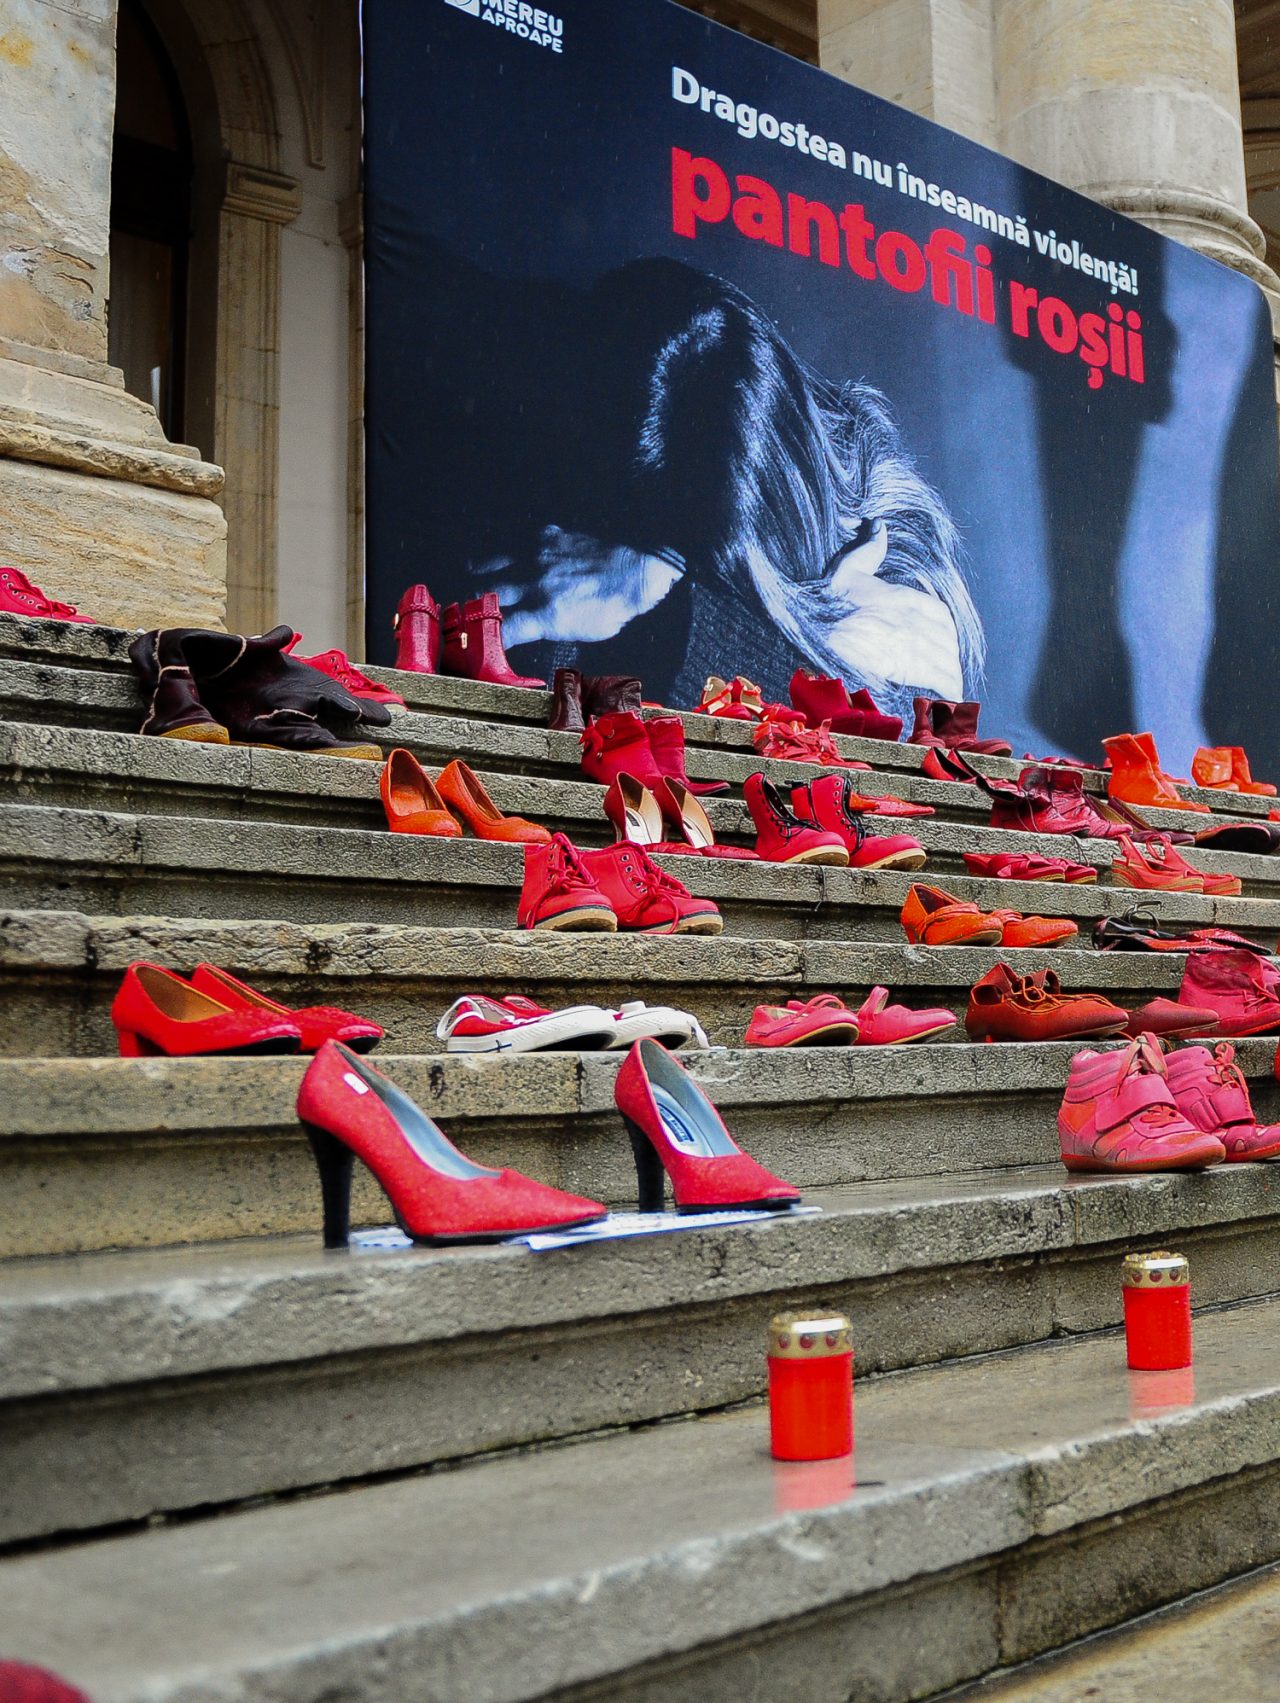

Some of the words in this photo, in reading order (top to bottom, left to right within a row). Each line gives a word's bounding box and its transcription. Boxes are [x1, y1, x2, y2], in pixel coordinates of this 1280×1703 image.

[481, 8, 564, 53] APROAPE
[672, 66, 848, 169] Dragostea
[852, 151, 893, 189] nu
[896, 162, 1031, 249] înseamnă
[1033, 229, 1140, 297] violență!
[672, 147, 996, 326] pantofii
[1009, 302, 1146, 391] roșii
